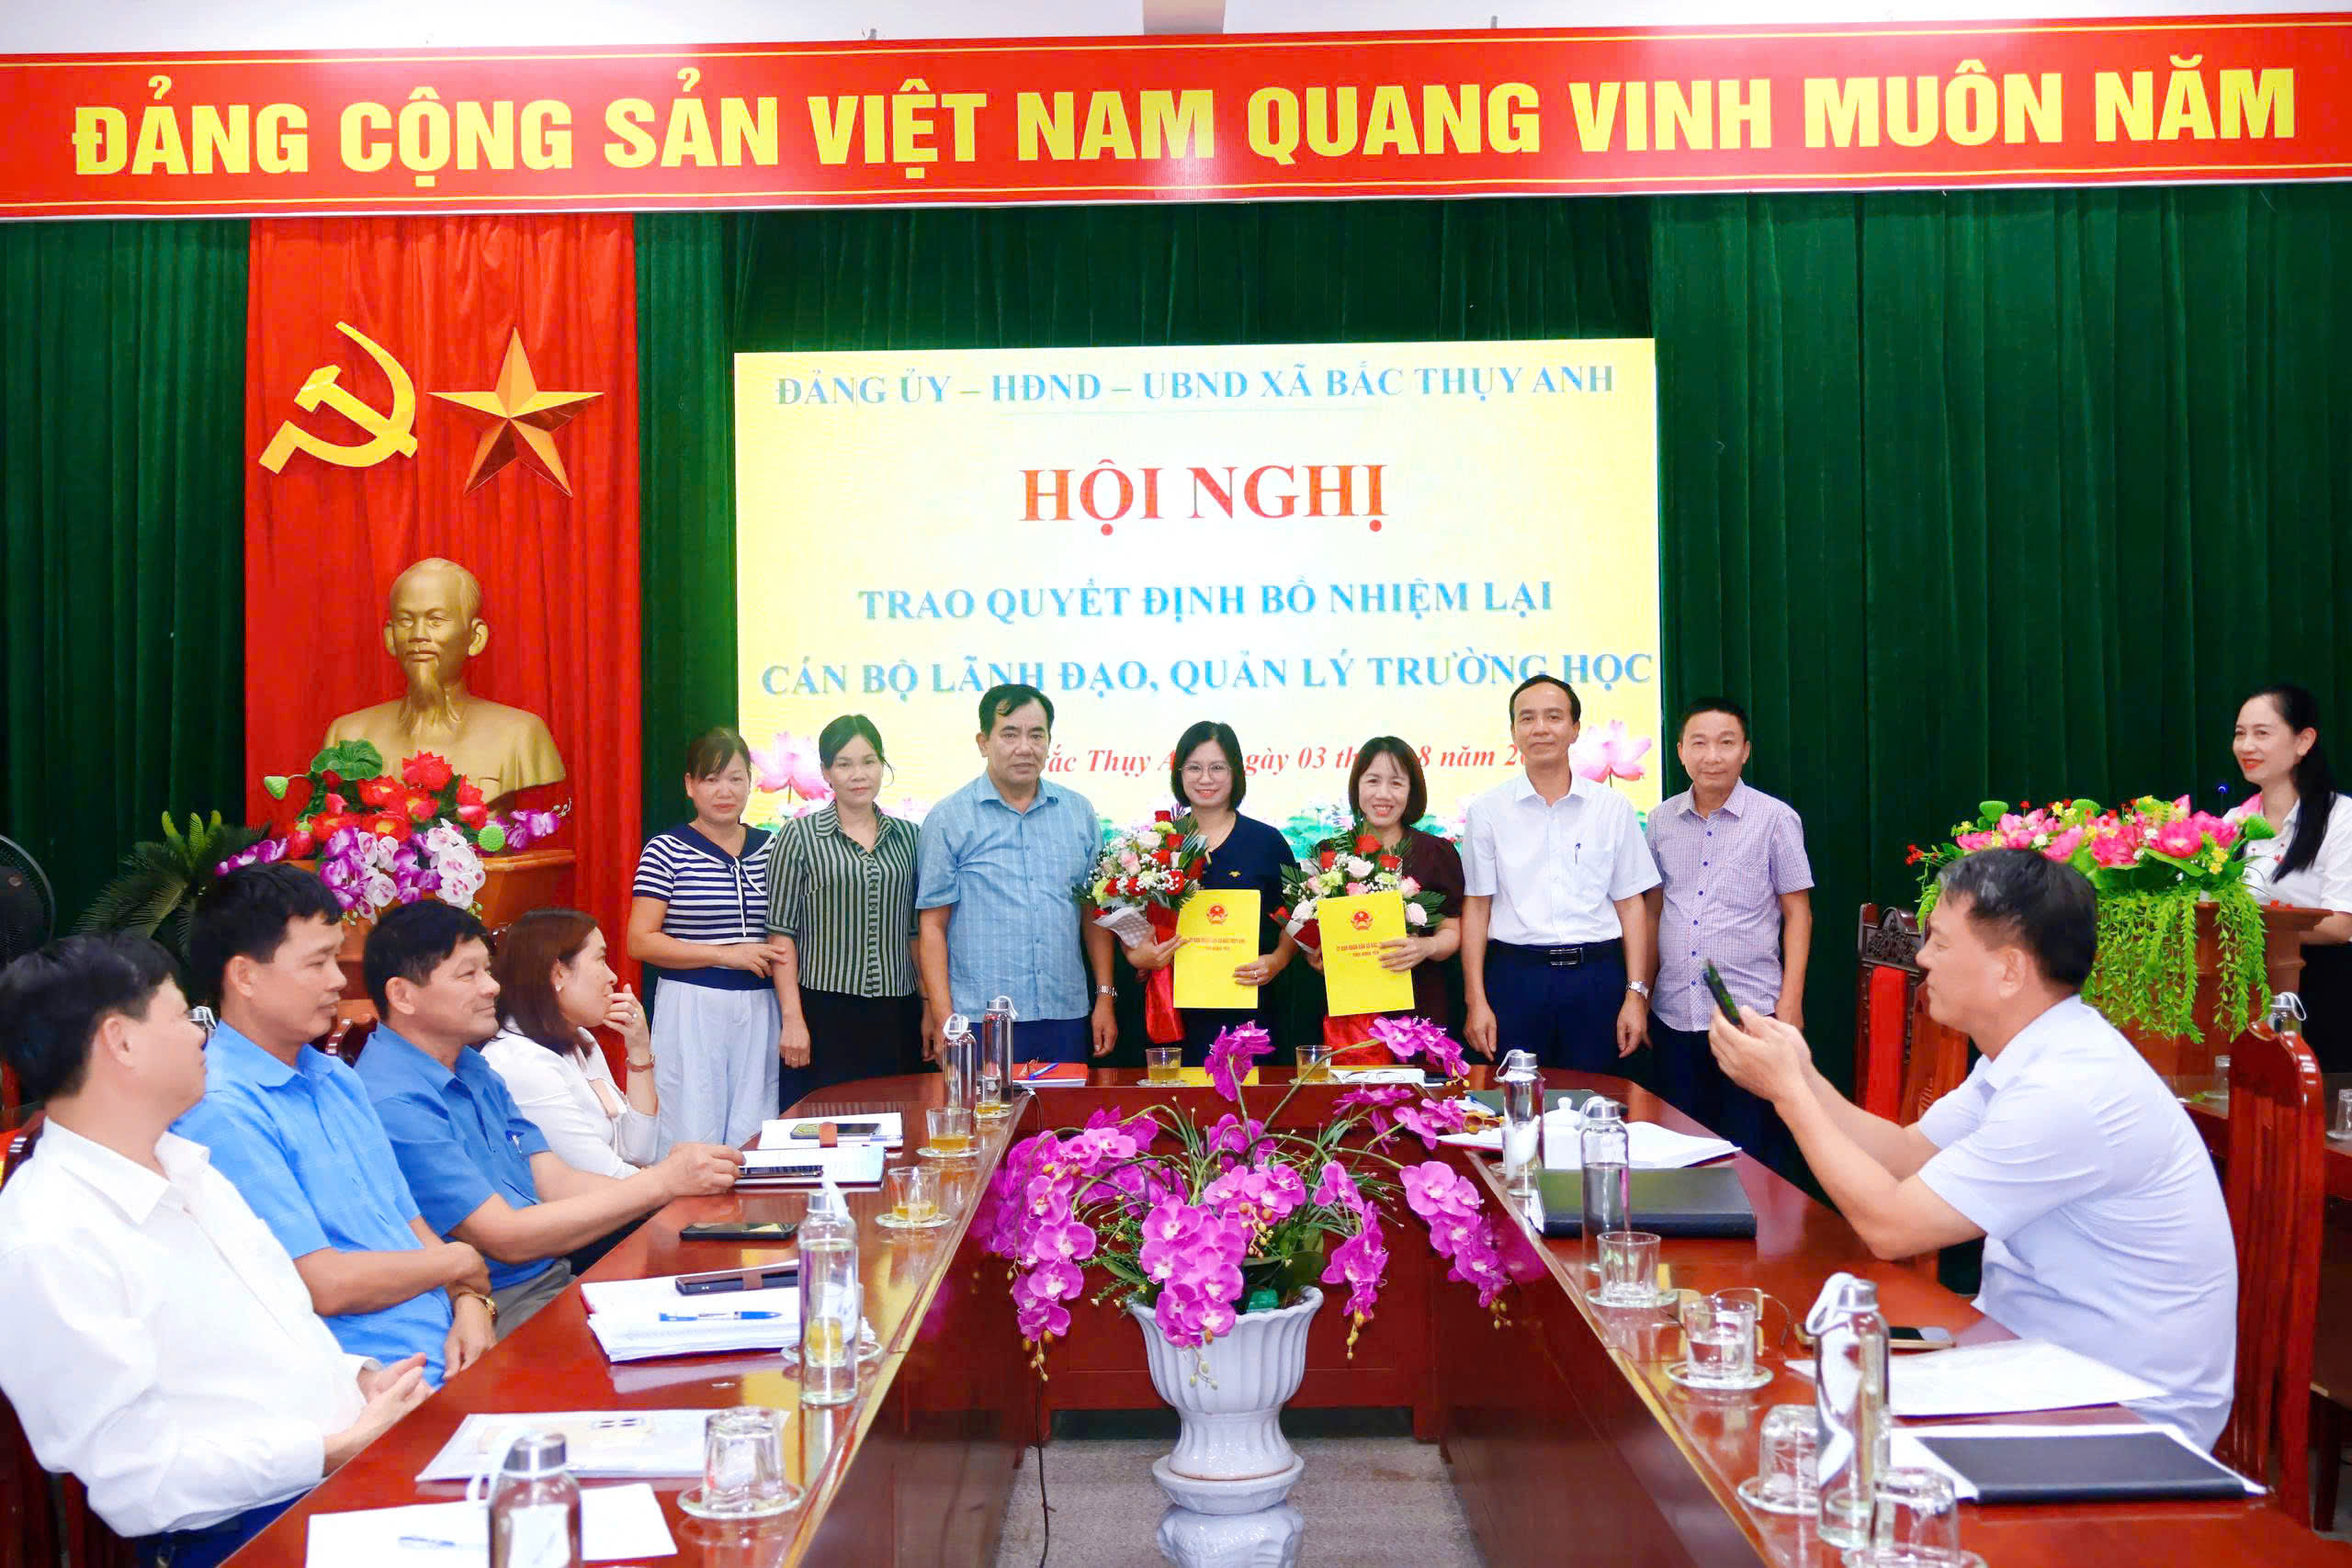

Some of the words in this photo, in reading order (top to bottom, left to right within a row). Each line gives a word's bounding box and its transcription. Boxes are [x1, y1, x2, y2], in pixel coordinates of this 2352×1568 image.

[72, 74, 309, 175] ĐẢNG
[340, 86, 573, 187] CỘNG
[604, 67, 779, 168] SẢN
[808, 78, 984, 179] VIỆT
[1017, 88, 1216, 162] NAM
[1247, 83, 1541, 165] QUANG
[1568, 77, 1772, 153] VINH
[1804, 59, 2064, 149] MUÔN
[2094, 53, 2296, 143] NĂM
[775, 368, 887, 405] ĐẢNG
[899, 367, 951, 403] ỦY
[992, 373, 1102, 402] HĐND
[1143, 370, 1249, 400] UBND
[1260, 363, 1313, 398] XÃ
[1326, 360, 1404, 397] BẮC
[1413, 367, 1522, 401] THỤY
[1532, 365, 1613, 394] ANH
[1017, 458, 1165, 536] HỘI
[1186, 464, 1389, 533] NGHỊ
[858, 589, 975, 620] TRAO
[986, 578, 1132, 625] QUYẾT
[1141, 585, 1246, 624] ĐỊNH
[1261, 575, 1317, 615] BỔ
[1329, 577, 1470, 621] NHIỆM
[1484, 581, 1552, 618] LẠI
[762, 655, 847, 695] CÁN
[862, 659, 919, 703] BỘ
[932, 655, 1045, 694] LÃNH
[1057, 659, 1159, 699] ĐẠO,
[1170, 649, 1286, 695] QUẢN
[1301, 648, 1354, 687] LÝ
[1366, 646, 1548, 686] TRƯỜNG
[1562, 653, 1653, 692] HỌC
[1047, 743, 1077, 773] ắc
[1088, 749, 1151, 778] Thụy
[1244, 747, 1290, 777] gày
[1297, 746, 1327, 770] 03
[1440, 744, 1496, 767] năm
